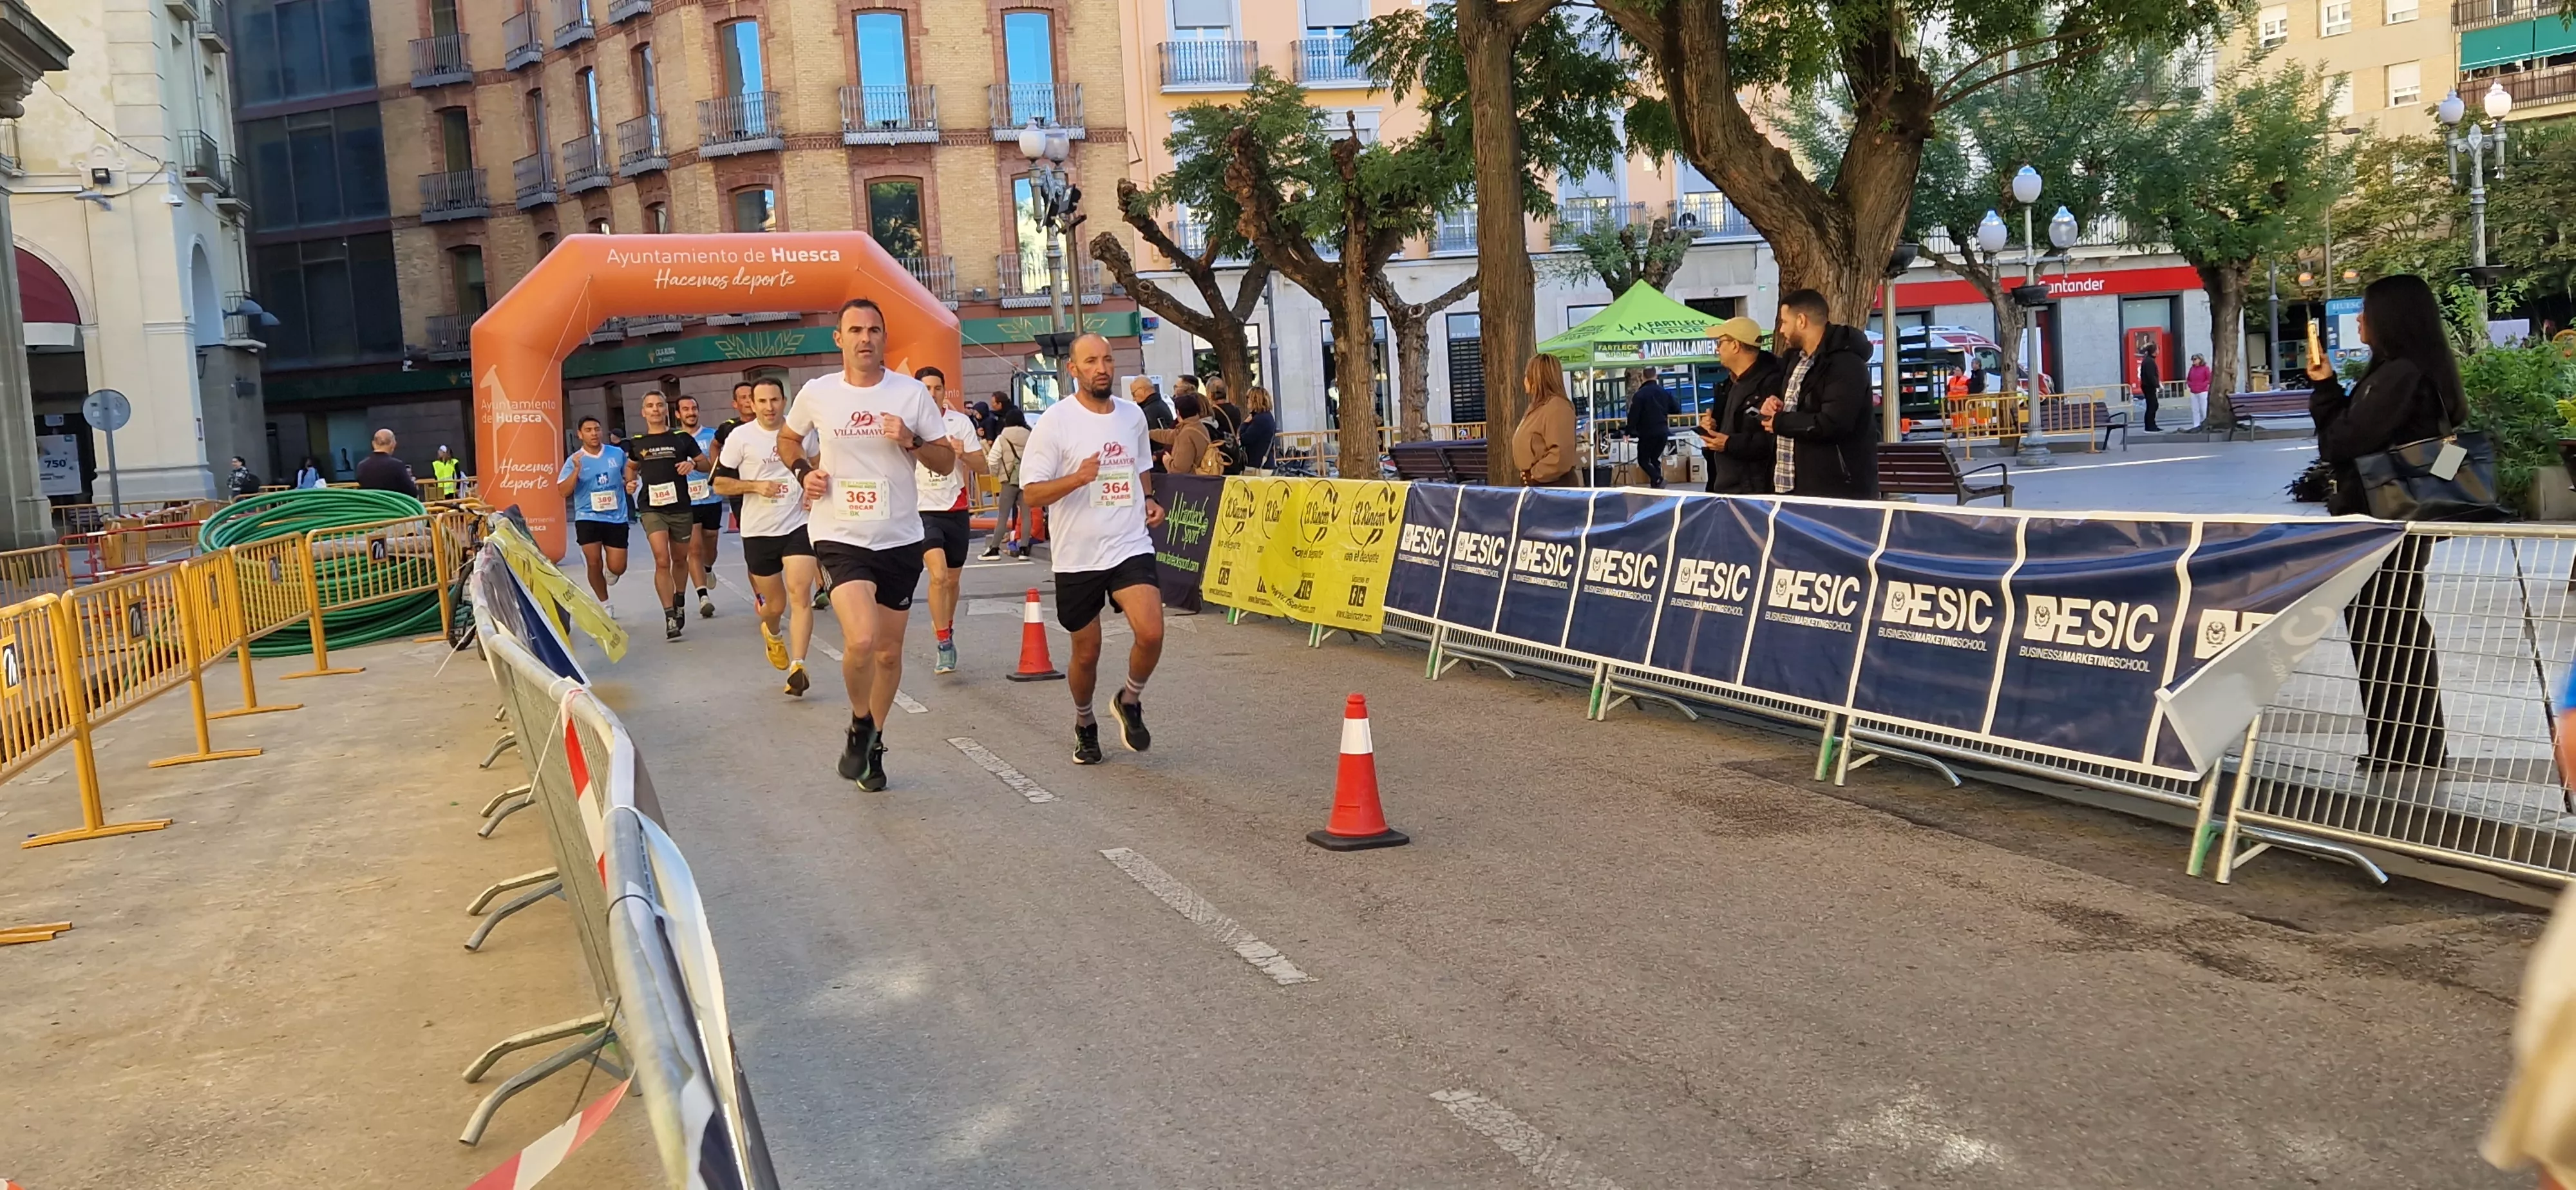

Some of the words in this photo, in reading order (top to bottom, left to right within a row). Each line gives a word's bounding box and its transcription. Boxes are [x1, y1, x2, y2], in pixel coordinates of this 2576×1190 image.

[607, 248, 738, 268] Ayuntamiento
[744, 248, 765, 263] de
[771, 247, 840, 263] Huesca
[653, 268, 729, 290] Hacemos
[732, 266, 797, 295] deporte
[2038, 278, 2105, 294] antander
[1714, 287, 1719, 297] 2
[2333, 301, 2364, 310] HUESC
[1649, 319, 1705, 328] FARTLECK
[1650, 340, 1718, 357] AVITUALLAMIEN
[481, 399, 556, 414] Ayuntamiento
[482, 413, 492, 424] de
[495, 412, 542, 423] Huesca
[834, 428, 886, 437] VILLAMAYO
[44, 459, 66, 469] 750
[499, 458, 554, 475] Hacemos
[500, 473, 549, 496] deporte
[1103, 482, 1130, 495] 364
[846, 491, 877, 504] 363
[1352, 501, 1364, 525] El
[1361, 500, 1386, 527] Rincón
[1411, 525, 1446, 556] ESIC
[1465, 533, 1506, 567] ESIC
[1528, 541, 1574, 577] ESIC
[1602, 549, 1658, 589] ESIC
[1692, 560, 1751, 602] ESIC
[1790, 571, 1861, 617] ESIC
[1670, 597, 1744, 616] BUSINESS&MARKETINGSCHOOL
[1909, 583, 1993, 634] ESIC
[1765, 610, 1853, 633] BUSINESS&MARKETINGSCHOOL
[2056, 597, 2159, 653] ESIC
[1878, 627, 1987, 652] BUSINESS&MARKETINGSCHOOL
[2019, 645, 2151, 673] BUSINESS&MARKETINGSCHOOL
